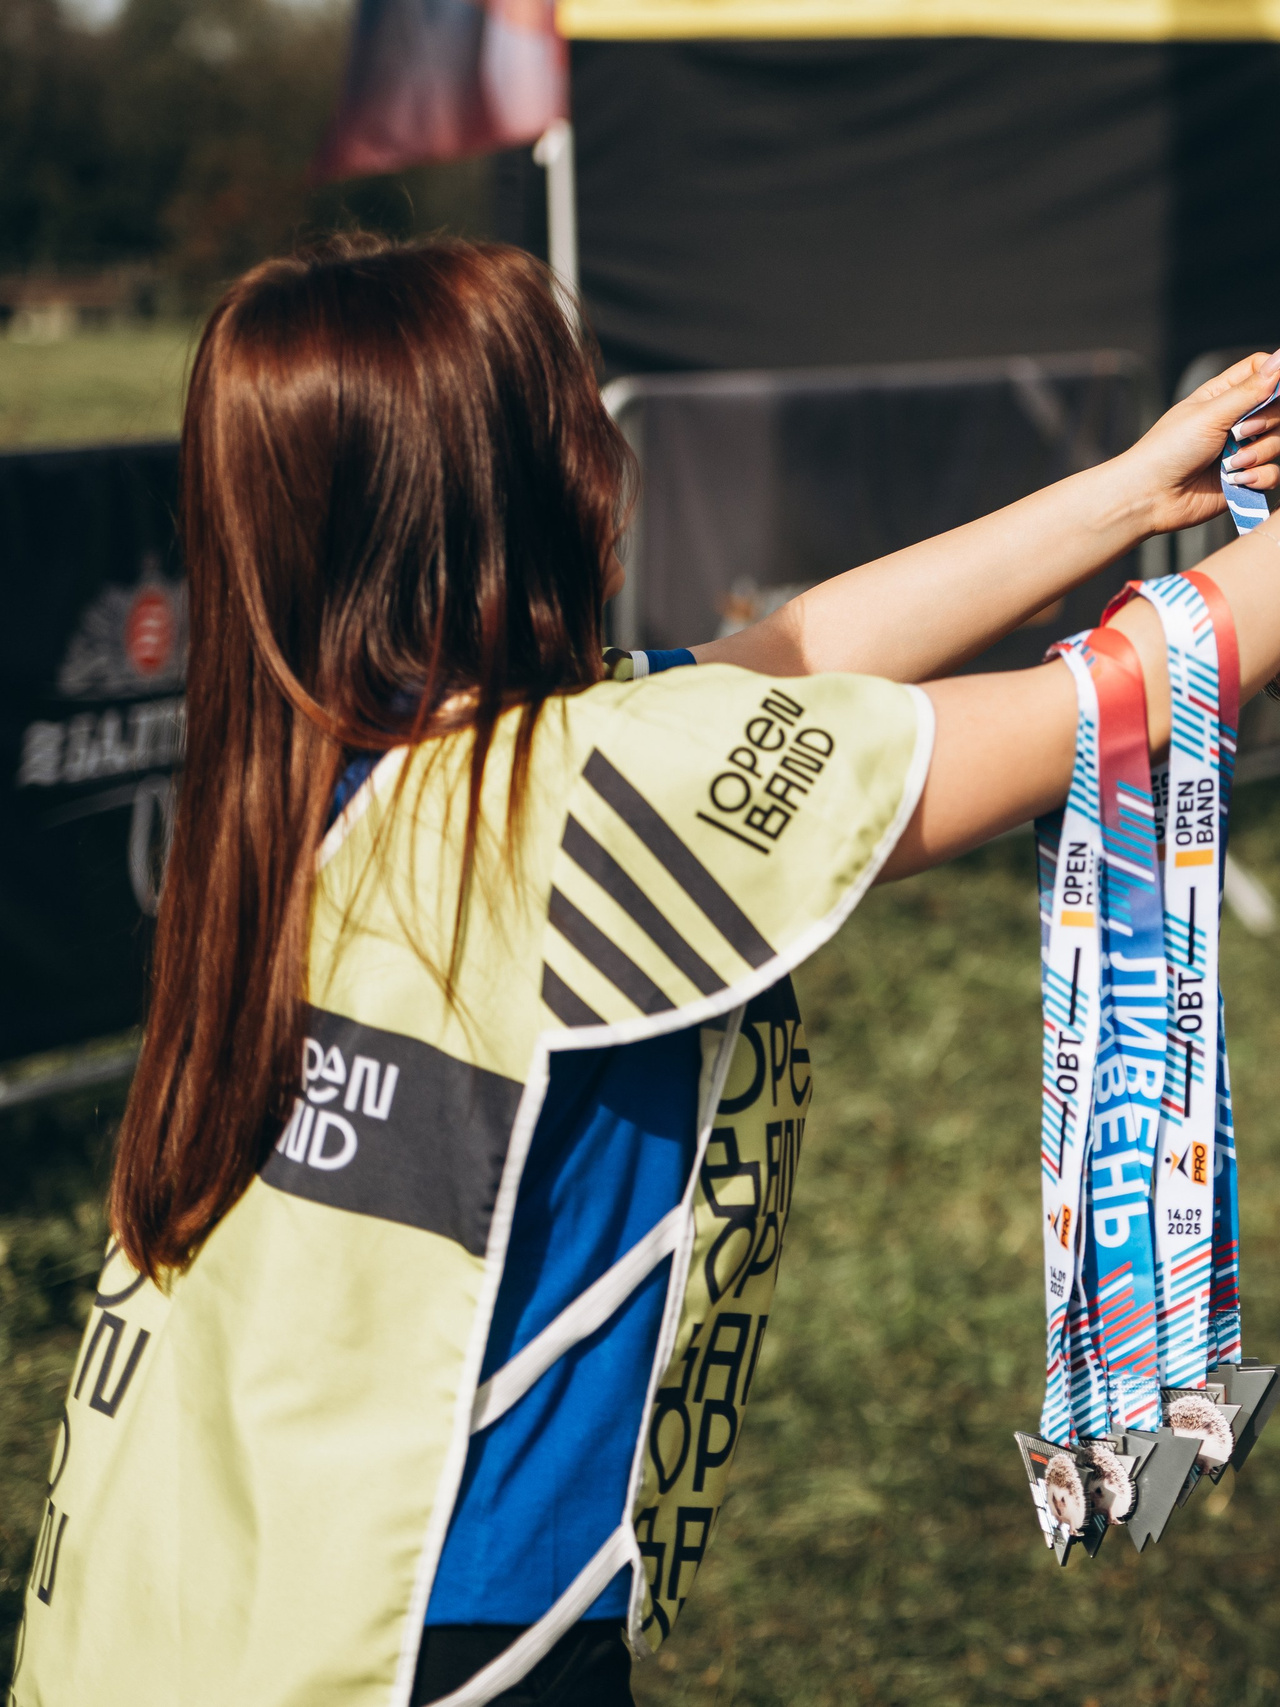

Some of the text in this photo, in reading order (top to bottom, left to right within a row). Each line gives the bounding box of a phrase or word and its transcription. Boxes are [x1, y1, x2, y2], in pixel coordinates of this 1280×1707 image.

[743, 727, 835, 842] BAND
[1175, 781, 1195, 846] OPEN
[1196, 778, 1215, 844] BAND
[1062, 842, 1089, 905] OPEN
[1194, 1144, 1206, 1184] PRO
[1168, 1208, 1203, 1221] 14.09
[1168, 1222, 1203, 1235] 2025
[1049, 1265, 1067, 1284] 14.09
[1049, 1280, 1065, 1299] 2025
